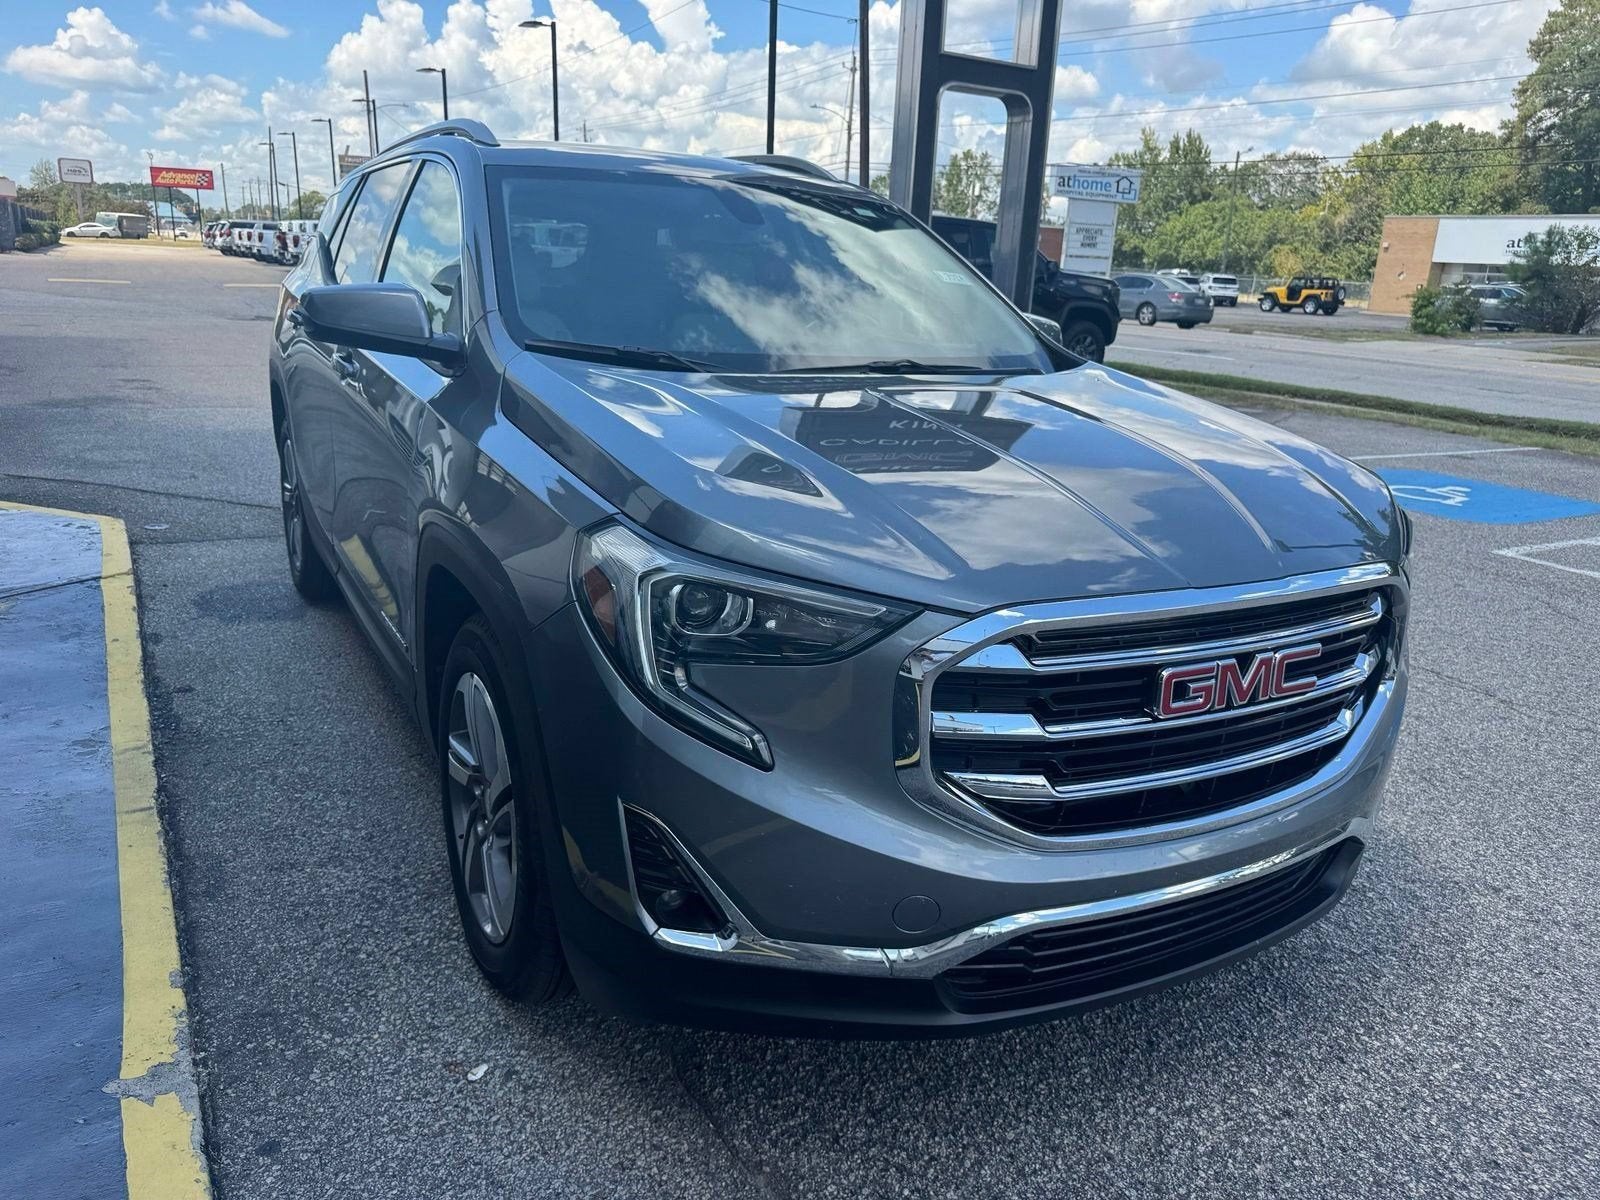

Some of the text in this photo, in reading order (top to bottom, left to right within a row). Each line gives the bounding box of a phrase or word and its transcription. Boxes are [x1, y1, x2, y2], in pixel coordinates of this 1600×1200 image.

[159, 170, 197, 179] Advance
[175, 177, 197, 185] Parts
[1057, 174, 1112, 193] athome
[1156, 643, 1322, 718] GMC
